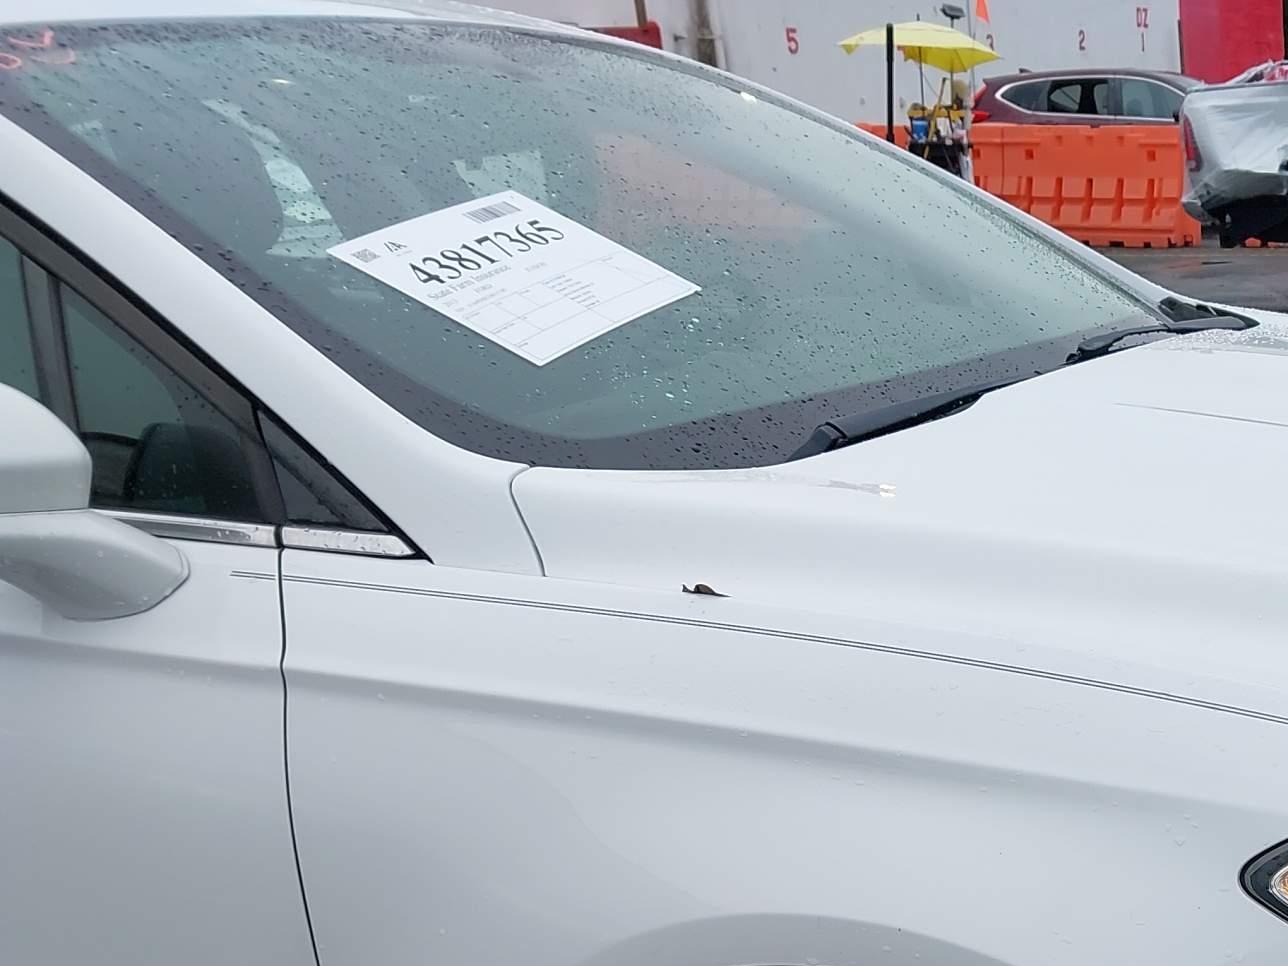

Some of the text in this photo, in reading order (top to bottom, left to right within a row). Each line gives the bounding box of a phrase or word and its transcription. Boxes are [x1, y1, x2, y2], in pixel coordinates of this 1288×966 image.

[786, 27, 799, 55] 5
[1078, 29, 1086, 51] 2
[409, 219, 564, 284] 43817365
